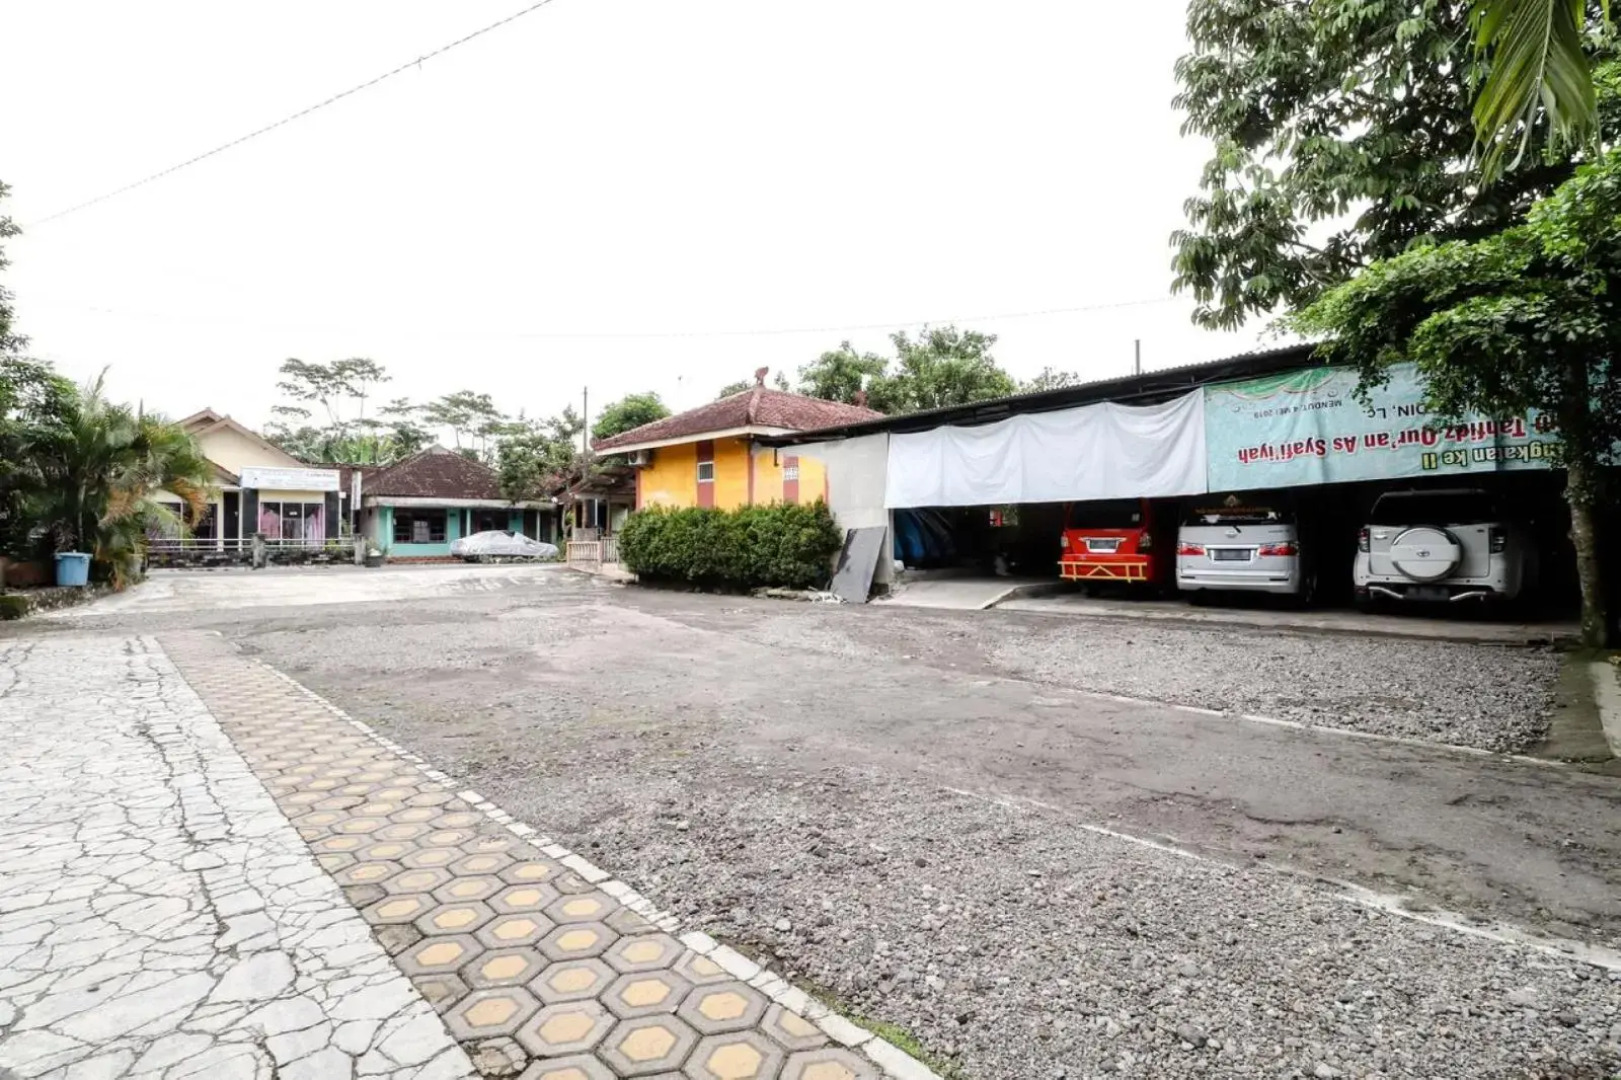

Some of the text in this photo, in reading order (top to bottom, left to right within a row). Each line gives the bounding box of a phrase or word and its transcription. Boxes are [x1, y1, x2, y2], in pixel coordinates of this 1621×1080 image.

[1364, 426, 1437, 449] Qur'an
[1445, 416, 1526, 441] Tahfidz
[1238, 437, 1326, 464] Syafi'iyah
[1332, 435, 1356, 451] As
[1442, 449, 1468, 466] ke
